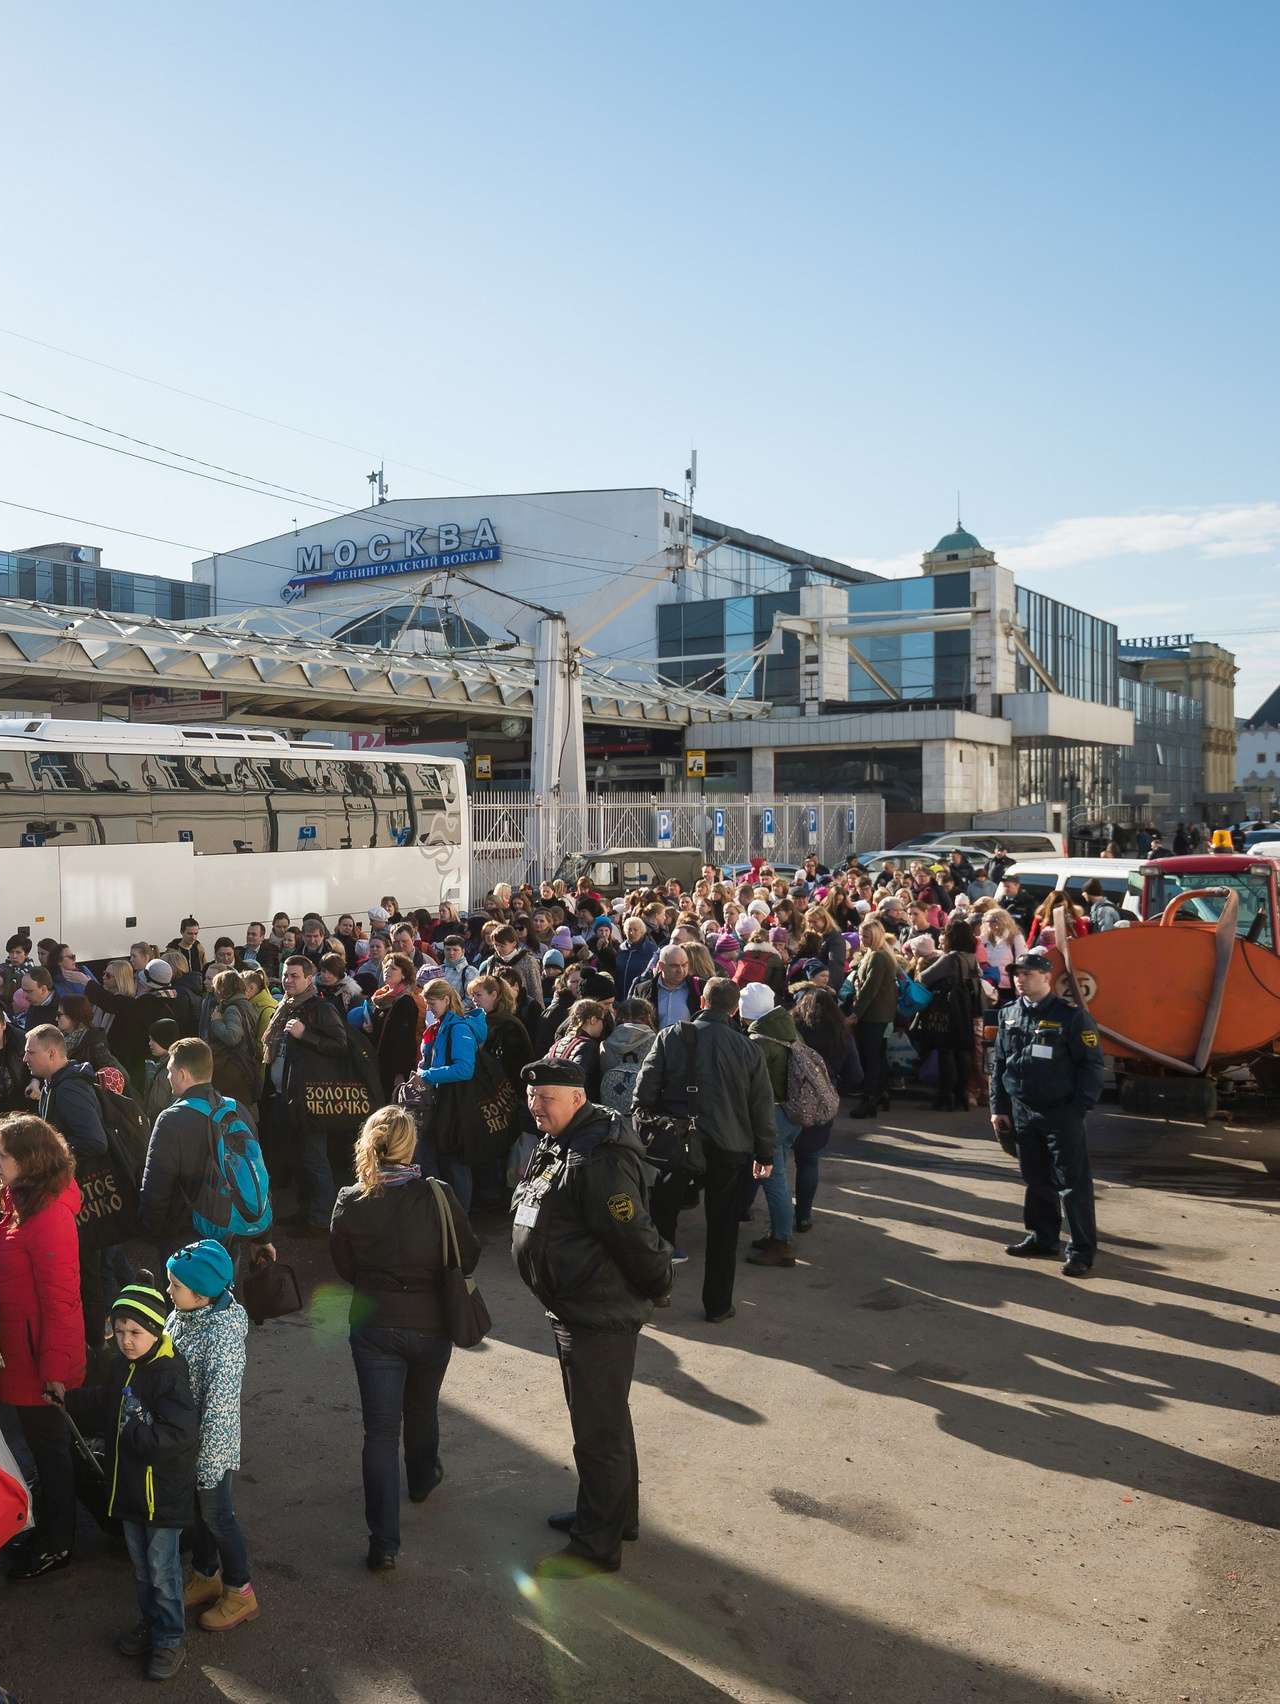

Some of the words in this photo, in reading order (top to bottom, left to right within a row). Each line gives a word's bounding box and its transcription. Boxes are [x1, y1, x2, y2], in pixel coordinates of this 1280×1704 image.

[297, 518, 499, 573] МОСКВА
[334, 555, 438, 581] ЛЕНИНГРАДСКИЙ
[442, 549, 494, 566] ВОКЗАЛ
[661, 814, 669, 837] P
[717, 812, 723, 834] P
[765, 811, 771, 831] P
[810, 811, 816, 829] P
[848, 811, 853, 828] P
[305, 1086, 369, 1100] ЗОЛОТОЕ
[306, 1100, 371, 1115] ЯБЛОЧКО
